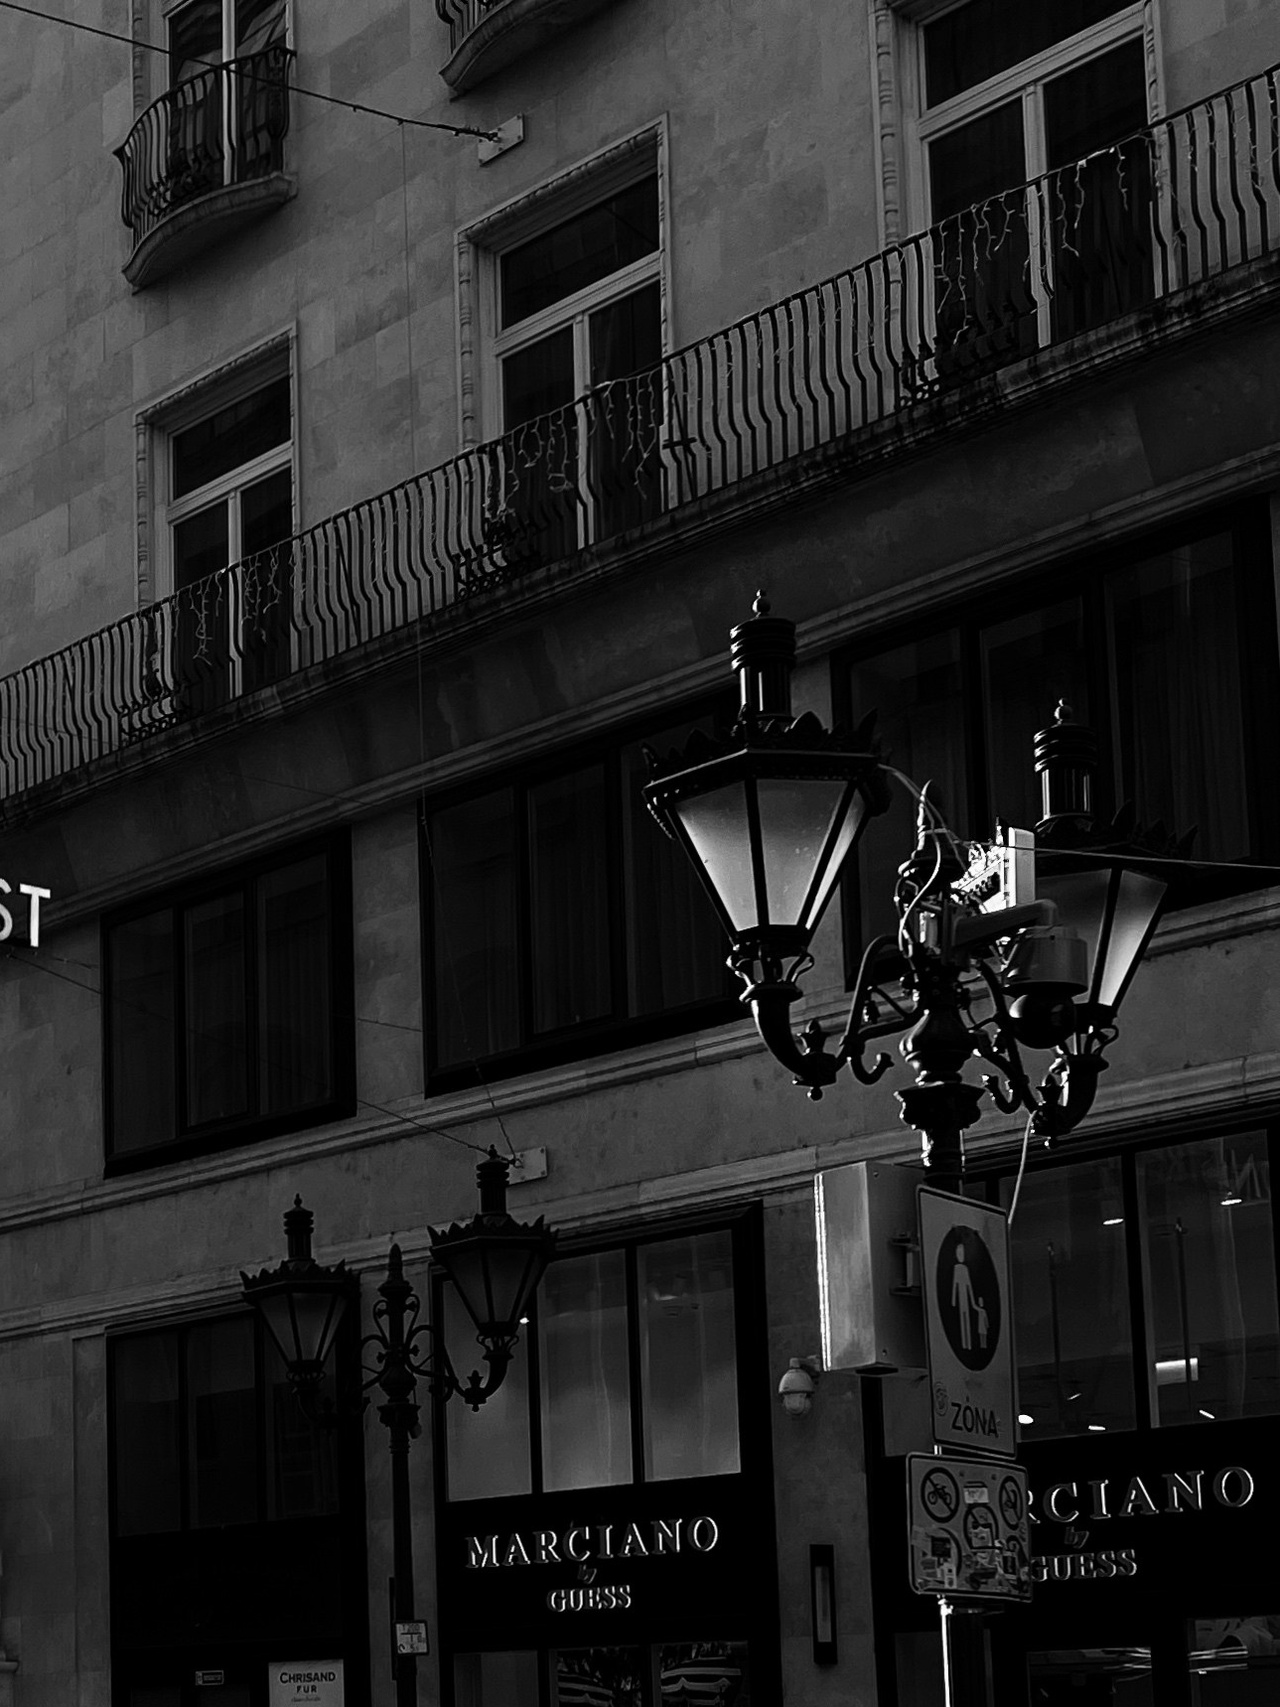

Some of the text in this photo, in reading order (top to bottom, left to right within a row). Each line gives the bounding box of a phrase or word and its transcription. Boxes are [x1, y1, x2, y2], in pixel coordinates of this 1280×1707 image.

[464, 1516, 719, 1568] MARCIANO
[1064, 1526, 1090, 1549] by
[577, 1564, 598, 1584] by
[1030, 1549, 1138, 1582] GUESS
[546, 1584, 632, 1612] GUESS
[279, 1672, 336, 1684] CHRISAND
[296, 1685, 317, 1693] FUR
